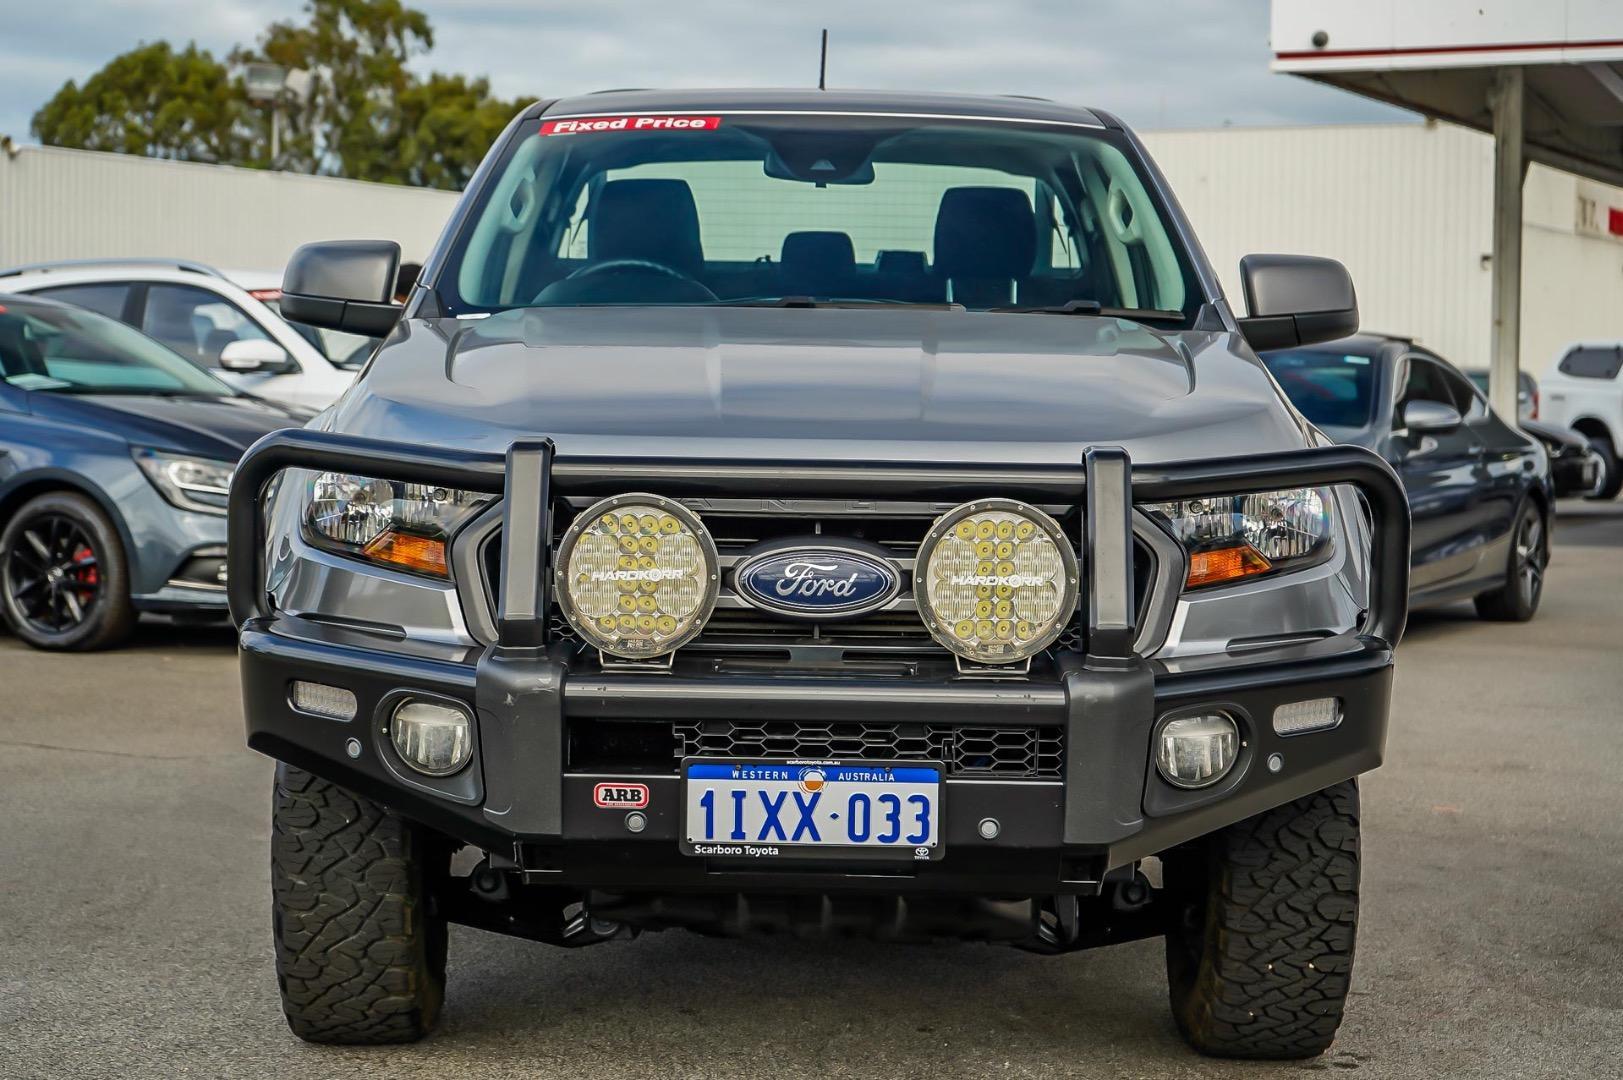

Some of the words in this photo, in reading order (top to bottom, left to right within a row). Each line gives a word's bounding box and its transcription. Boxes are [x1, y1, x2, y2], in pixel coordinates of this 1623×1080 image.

[553, 118, 626, 133] Fixed
[635, 117, 707, 129] Price
[775, 562, 859, 597] Ford
[732, 770, 788, 780] WESTERN
[838, 772, 895, 782] AUSTRALIA
[602, 788, 642, 802] ARB
[694, 844, 742, 855] Scarboro
[744, 845, 779, 856] Toyota
